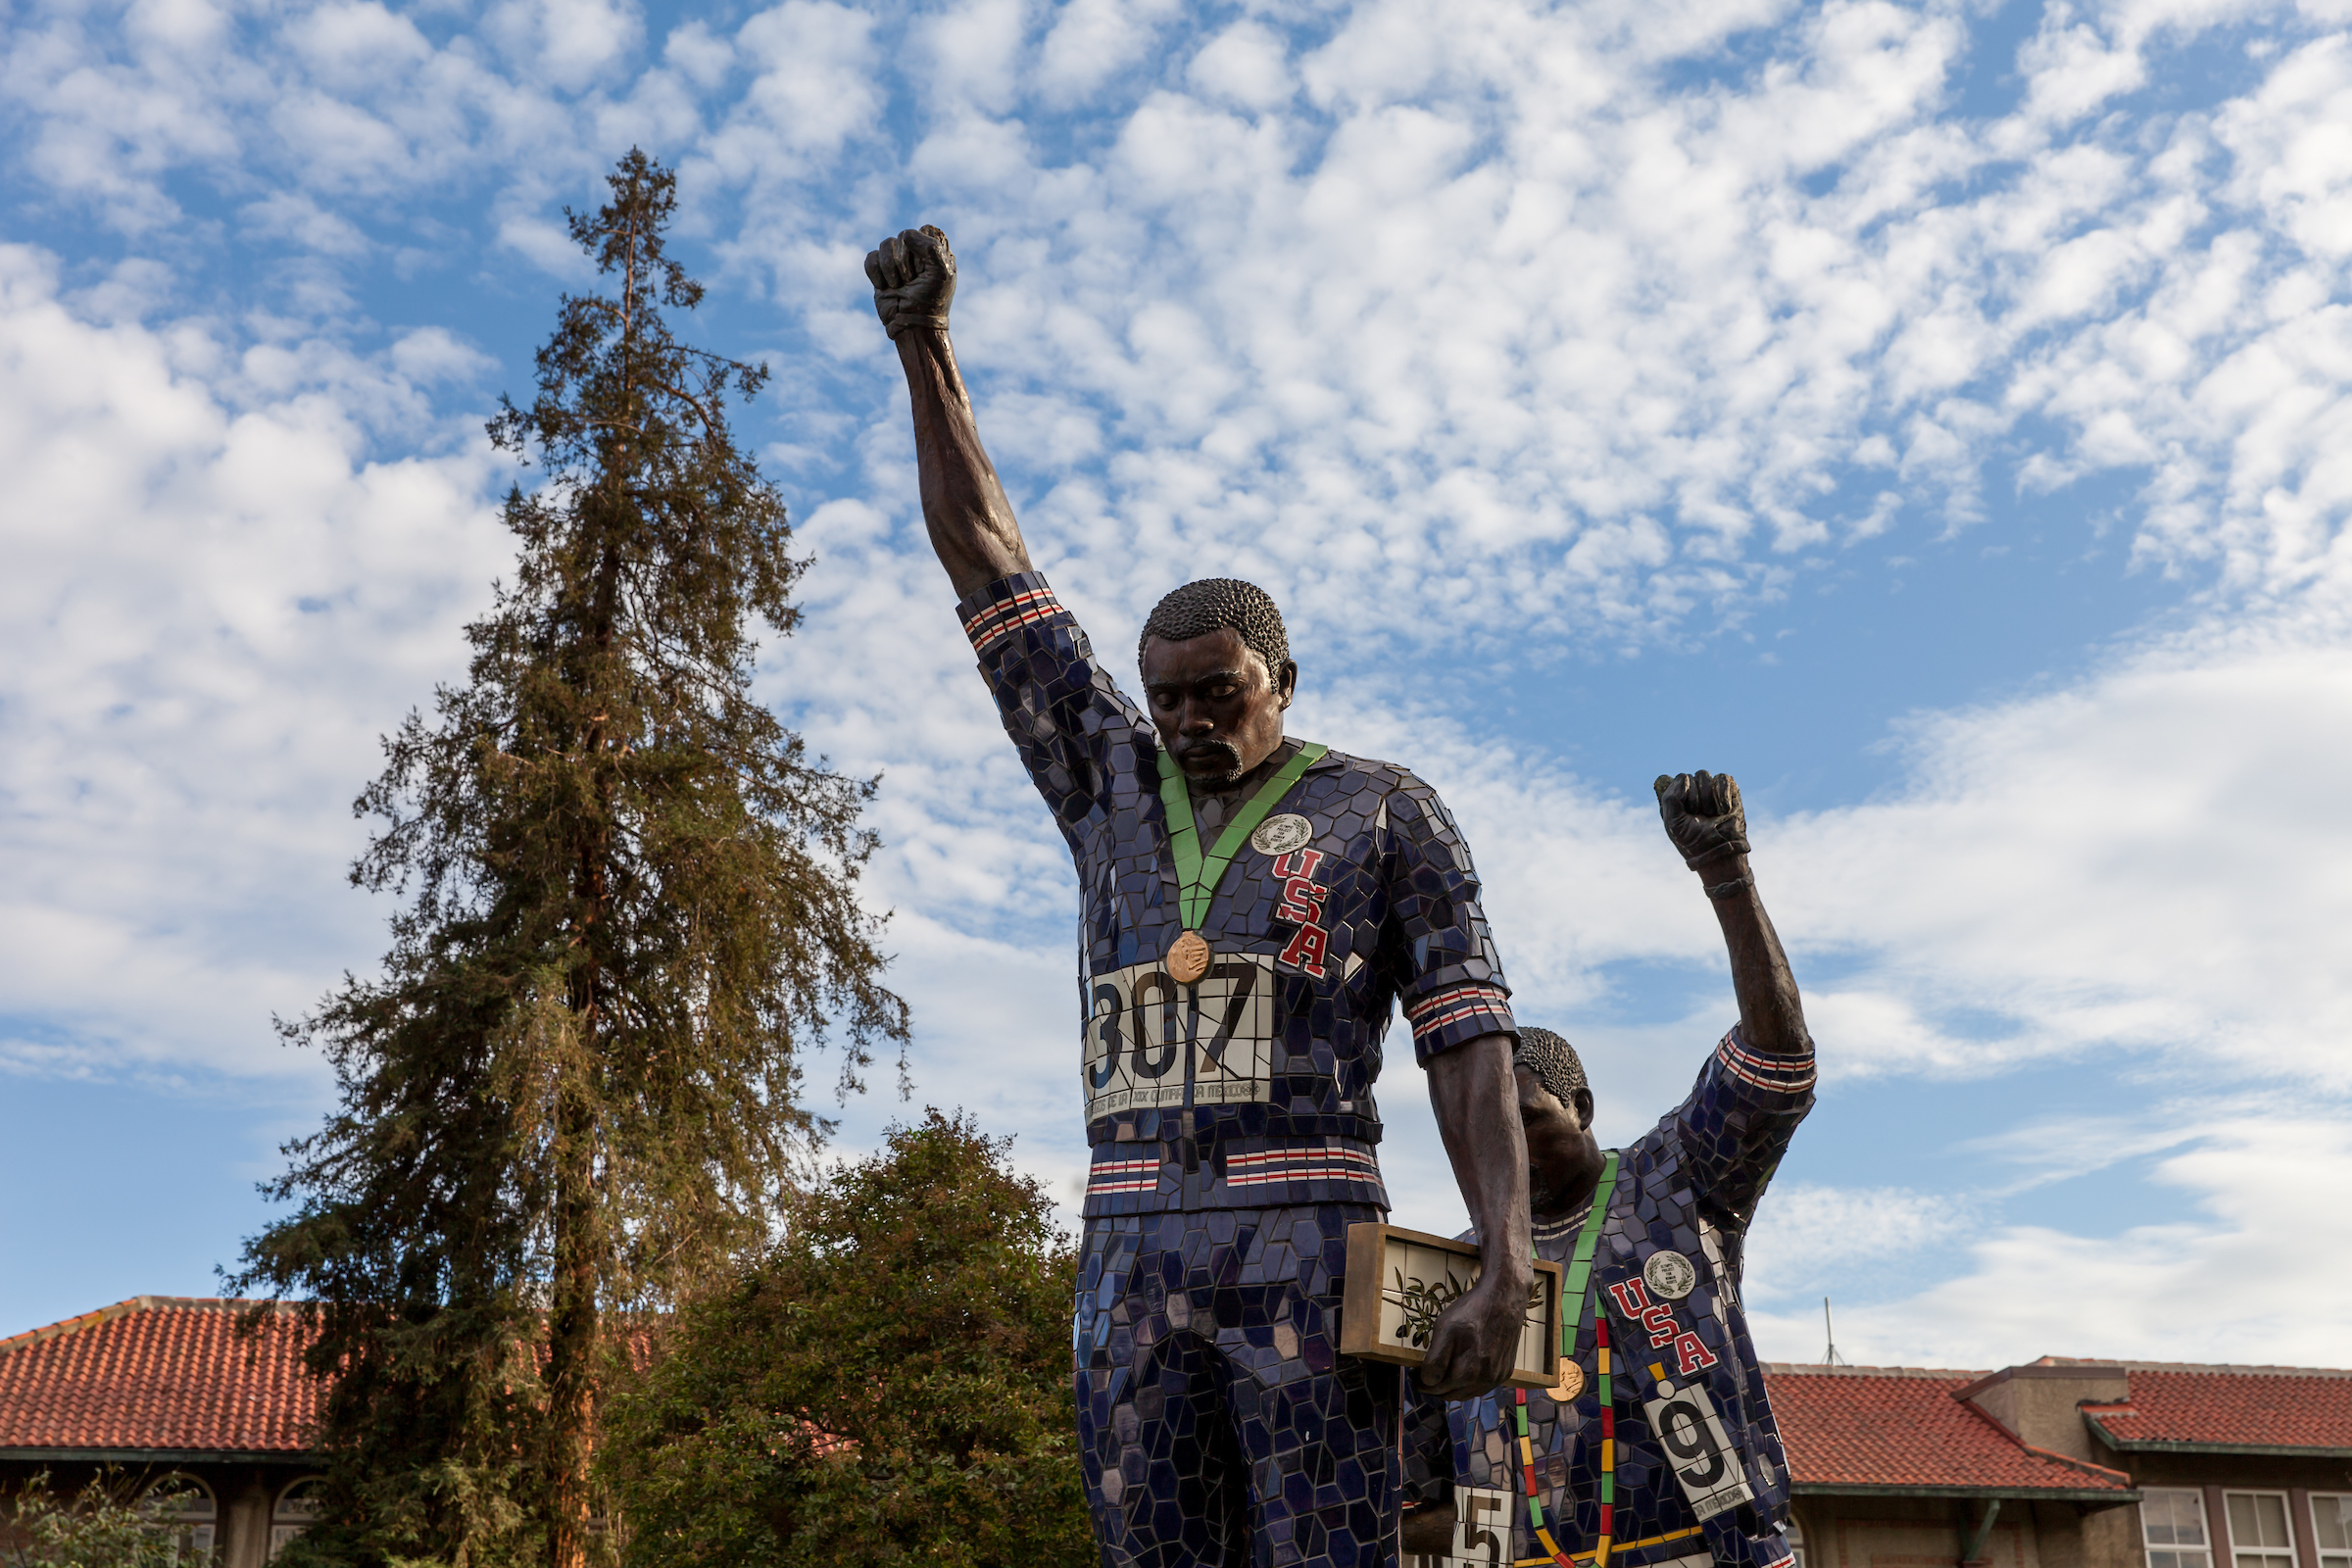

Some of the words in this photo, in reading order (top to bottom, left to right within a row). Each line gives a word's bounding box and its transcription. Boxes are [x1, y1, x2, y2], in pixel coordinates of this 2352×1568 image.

[1272, 848, 1329, 980] USA
[1090, 962, 1257, 1089] 307
[1133, 1090, 1149, 1102] XIX
[1608, 1276, 1718, 1377] USA
[1658, 1400, 1725, 1488] 9
[1463, 1495, 1500, 1568] 5
